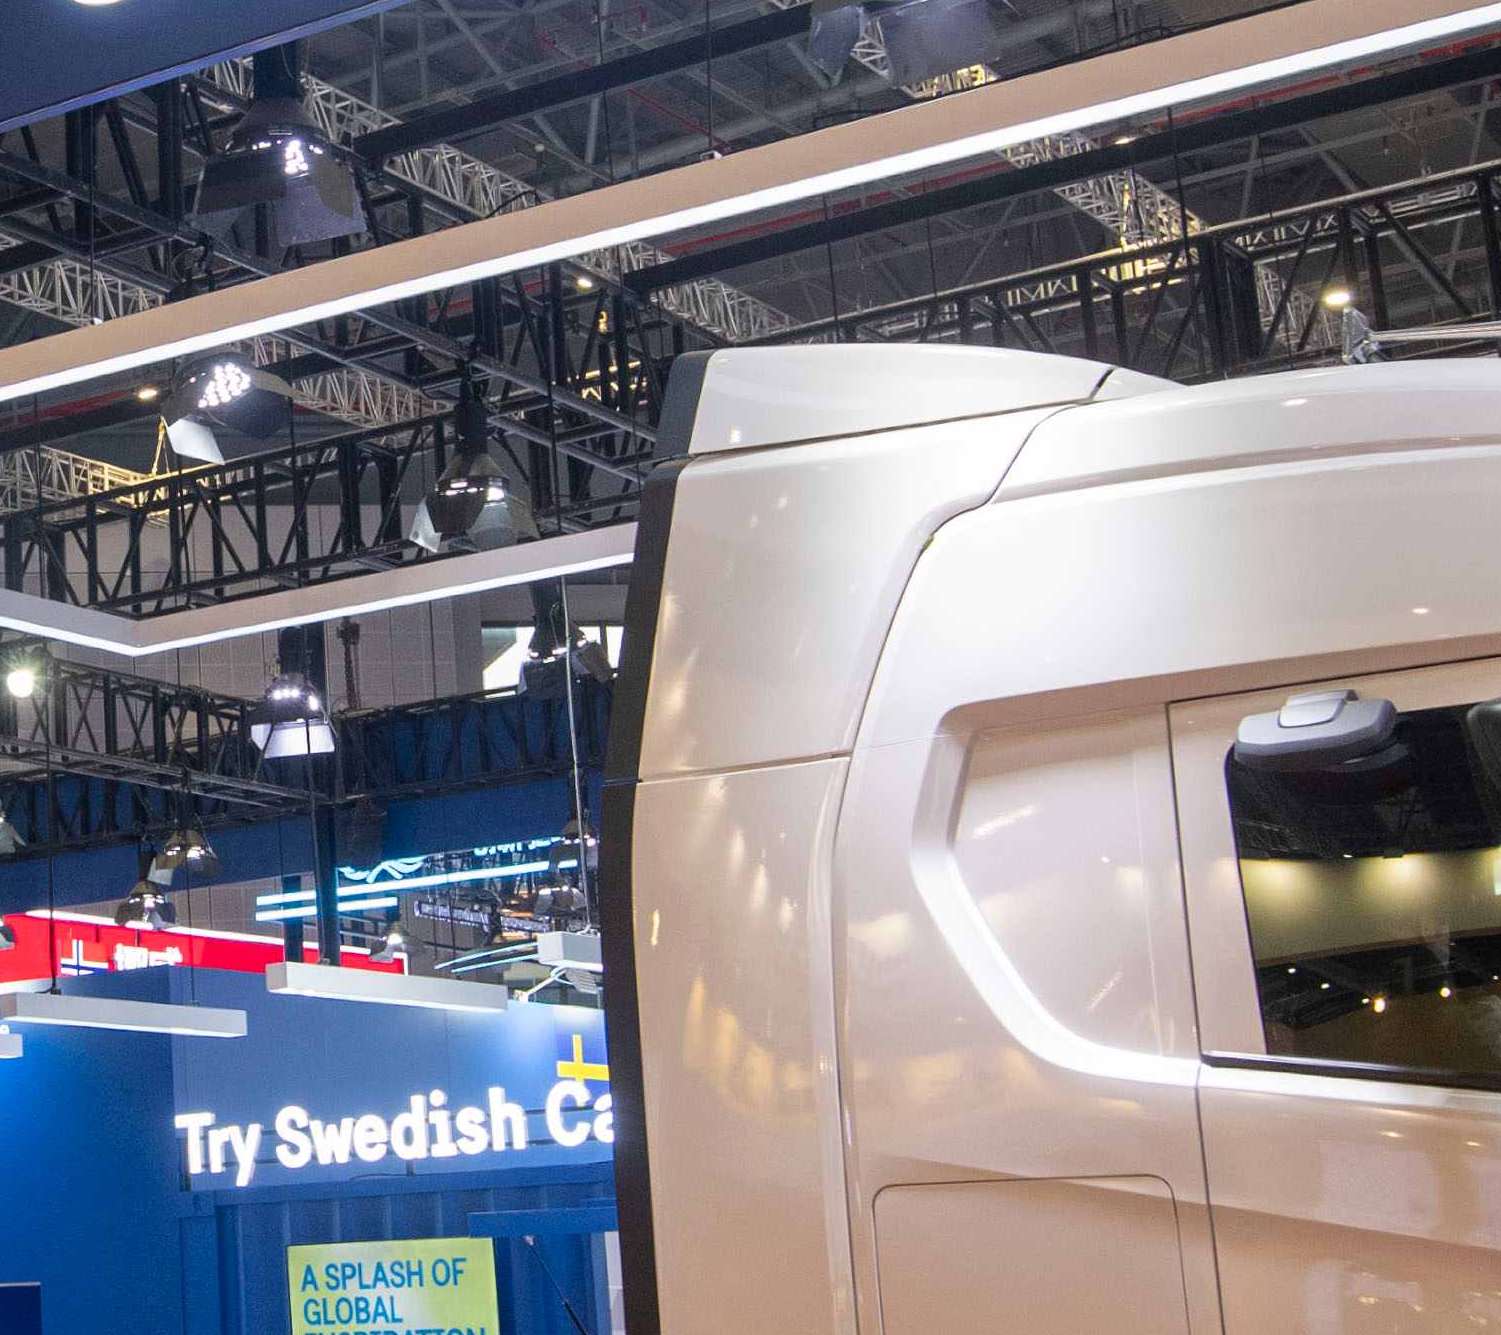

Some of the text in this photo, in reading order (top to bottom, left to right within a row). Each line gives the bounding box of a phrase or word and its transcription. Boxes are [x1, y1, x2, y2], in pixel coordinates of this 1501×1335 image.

[175, 1080, 615, 1187] Try Swedish Ca
[301, 1258, 467, 1292] A SPLASH OF
[303, 1296, 403, 1326] GLOBAL
